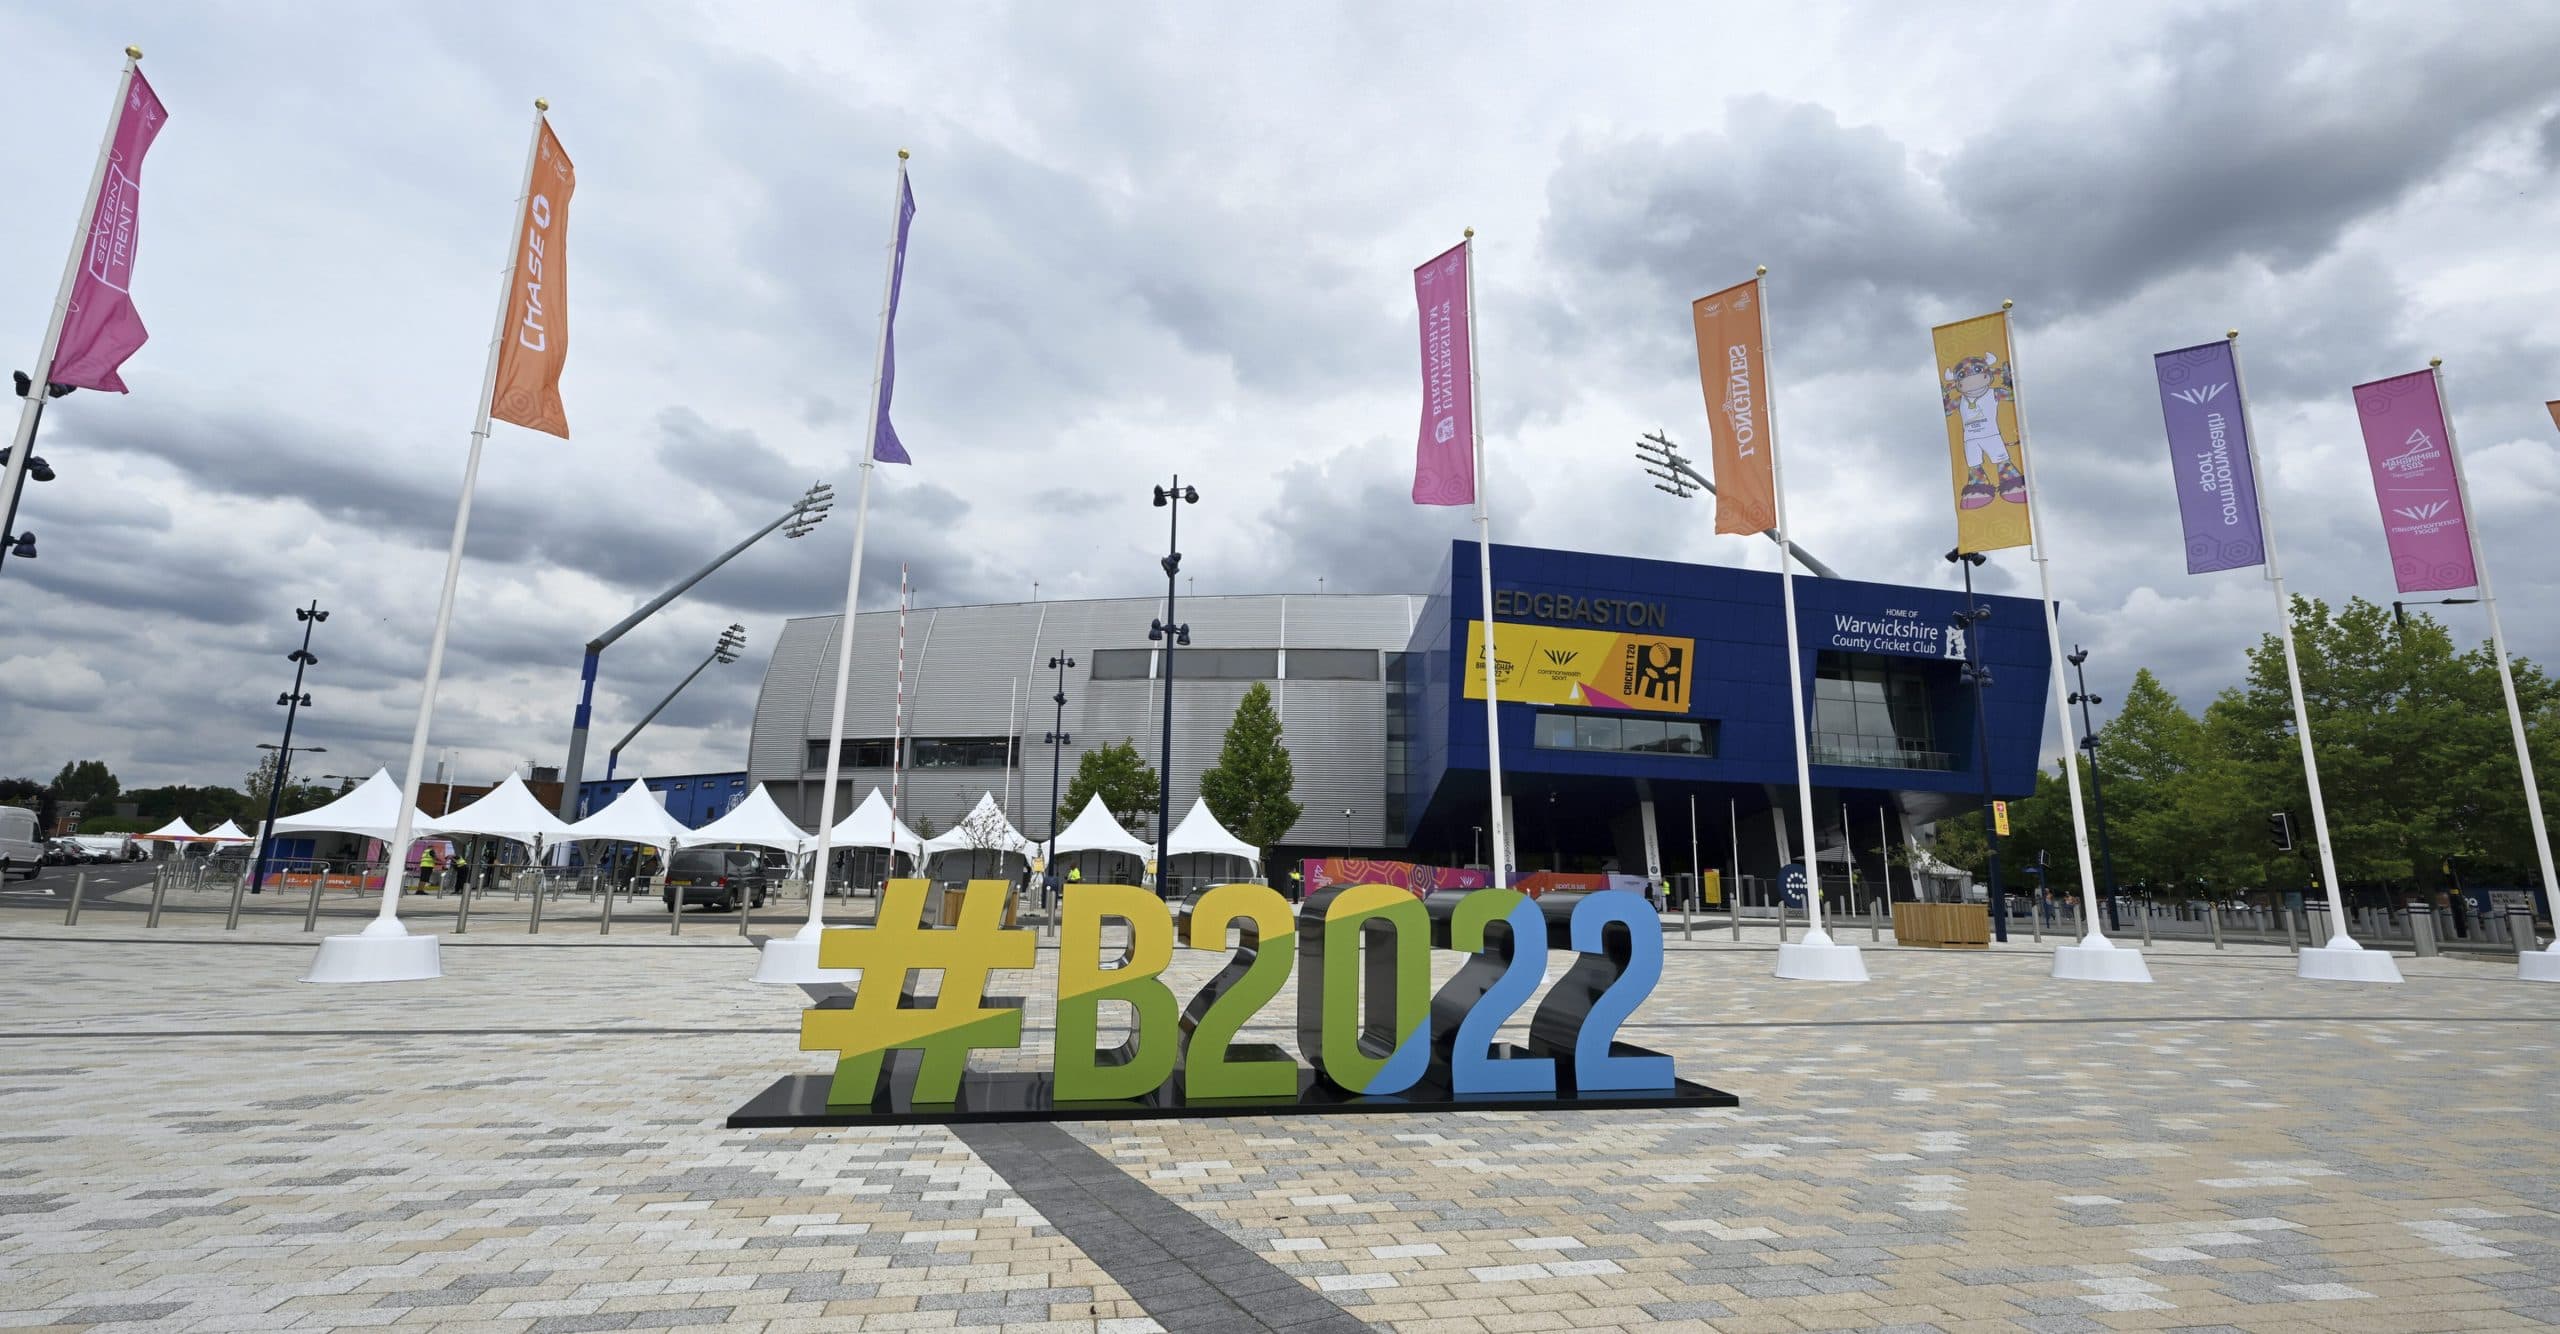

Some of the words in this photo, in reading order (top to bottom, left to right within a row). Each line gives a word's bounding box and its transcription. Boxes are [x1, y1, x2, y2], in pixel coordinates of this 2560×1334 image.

[96, 181, 119, 264] SEVERN
[112, 202, 137, 267] TRENT
[519, 233, 546, 352] CHASE
[1493, 590, 1667, 629] EDGBASTON
[1834, 614, 1938, 640] Warwickshire
[1886, 608, 1907, 618] HOME
[1908, 610, 1919, 618] OF
[1626, 643, 1636, 659] T20
[1832, 634, 1871, 652] County
[1873, 637, 1910, 652] Cricket
[1912, 641, 1937, 654] Club
[1623, 660, 1636, 696] CRICKET
[799, 878, 1677, 1106] #B2022
